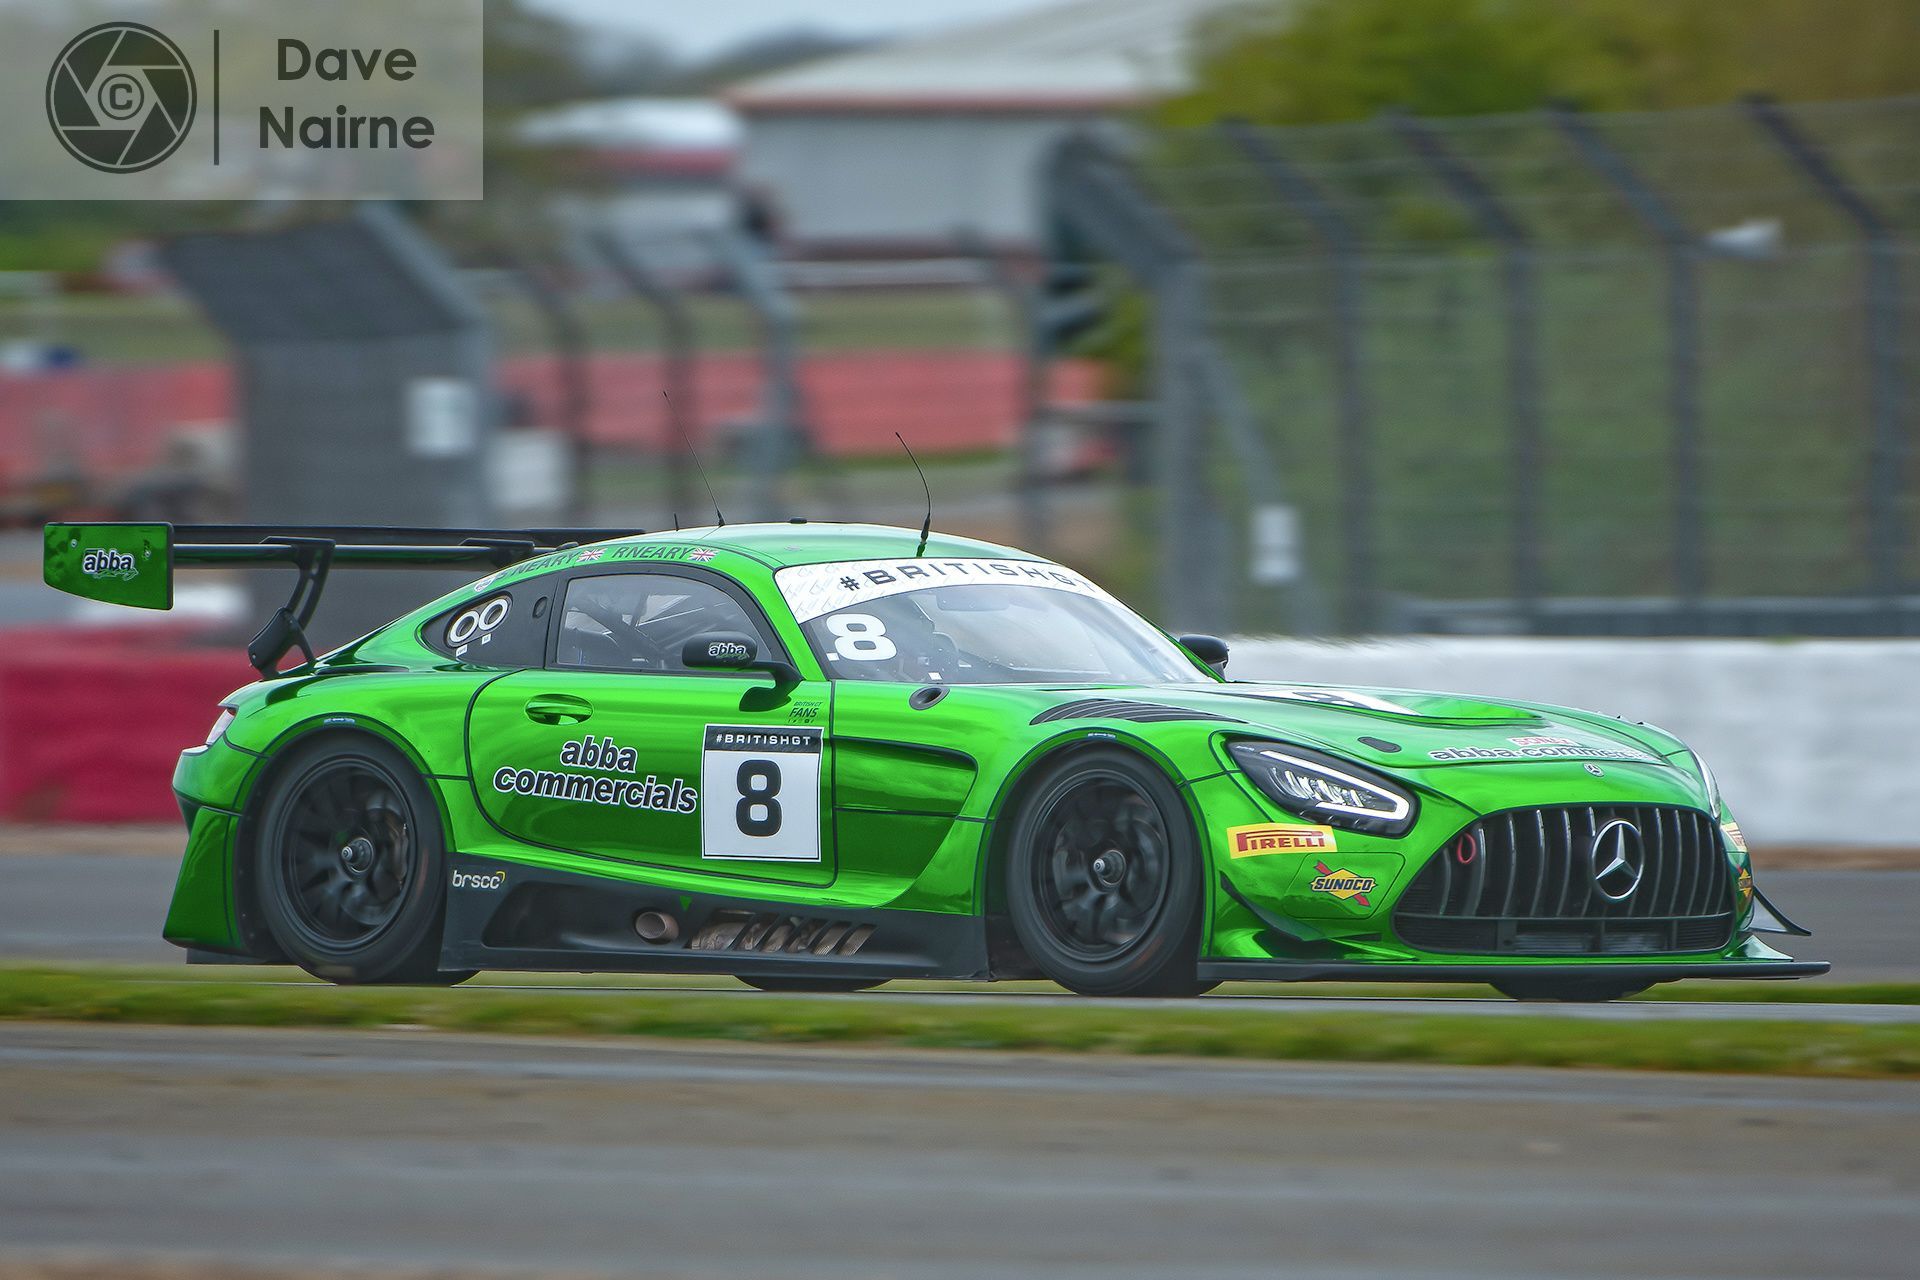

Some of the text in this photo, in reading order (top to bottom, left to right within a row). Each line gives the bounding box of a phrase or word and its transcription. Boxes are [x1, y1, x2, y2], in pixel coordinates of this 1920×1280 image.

[83, 549, 135, 573] abba
[826, 613, 898, 661] 8
[708, 642, 747, 657] abba
[789, 707, 819, 718] FANS
[716, 733, 811, 746] #BRITISHGT
[559, 735, 638, 773] abba
[493, 766, 698, 814] commercials
[735, 758, 783, 837] 8
[1236, 829, 1325, 852] PIRELLI
[452, 869, 500, 889] brscc
[1314, 878, 1373, 891] SUNOCO
